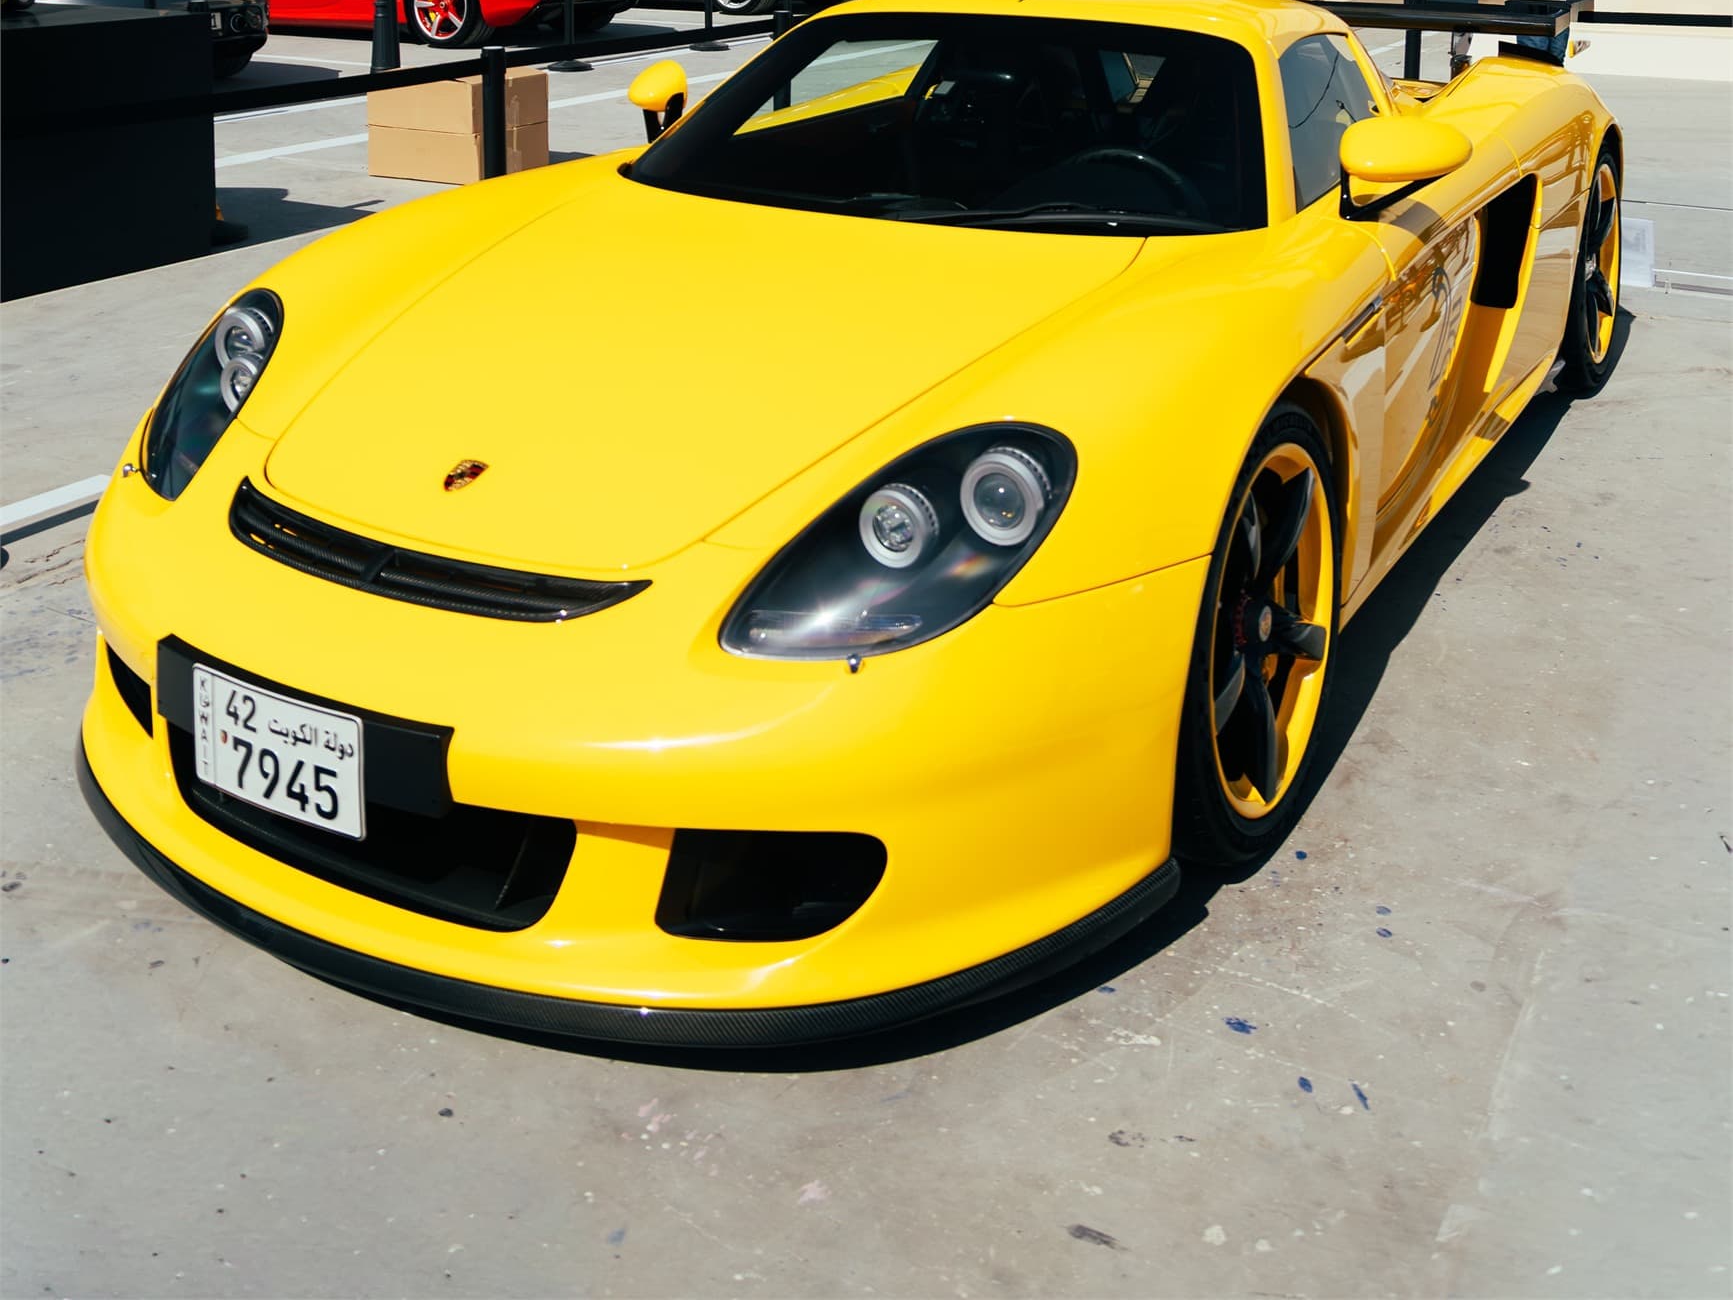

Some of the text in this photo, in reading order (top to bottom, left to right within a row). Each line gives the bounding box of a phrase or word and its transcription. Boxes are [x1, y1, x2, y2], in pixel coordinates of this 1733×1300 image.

[226, 689, 257, 733] 42
[268, 718, 354, 761] دولة الكويت
[232, 735, 339, 821] 7945
